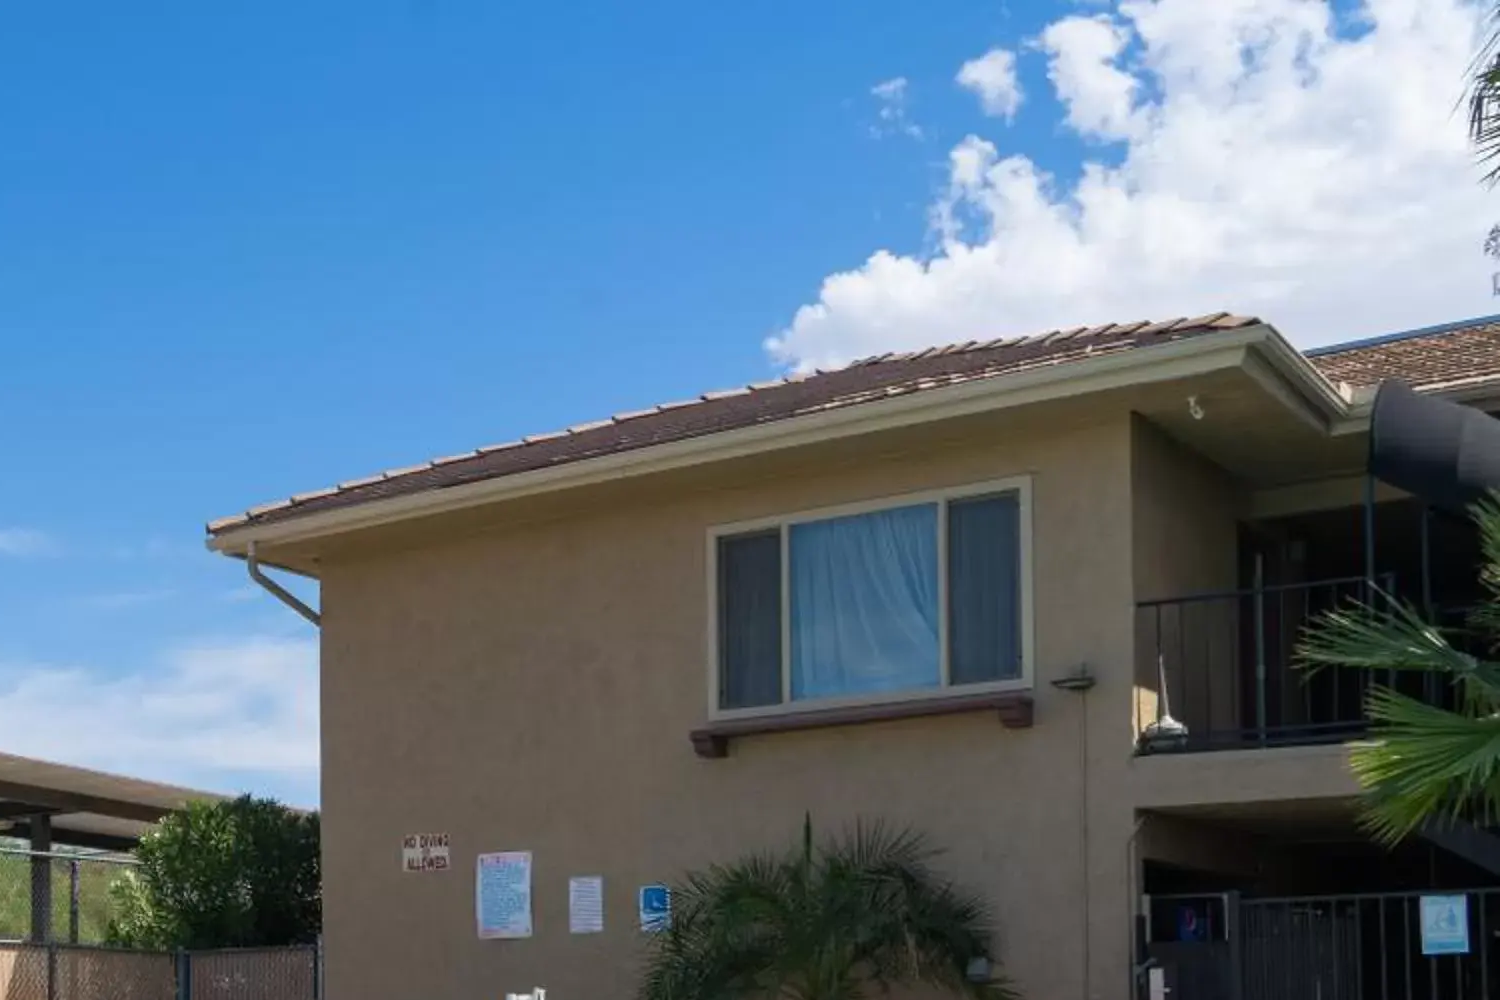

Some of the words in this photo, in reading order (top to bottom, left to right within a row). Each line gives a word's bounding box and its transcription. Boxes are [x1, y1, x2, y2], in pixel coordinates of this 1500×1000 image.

[404, 836, 417, 849] NO
[419, 834, 449, 849] DIVING
[407, 855, 448, 871] ALLOWED
